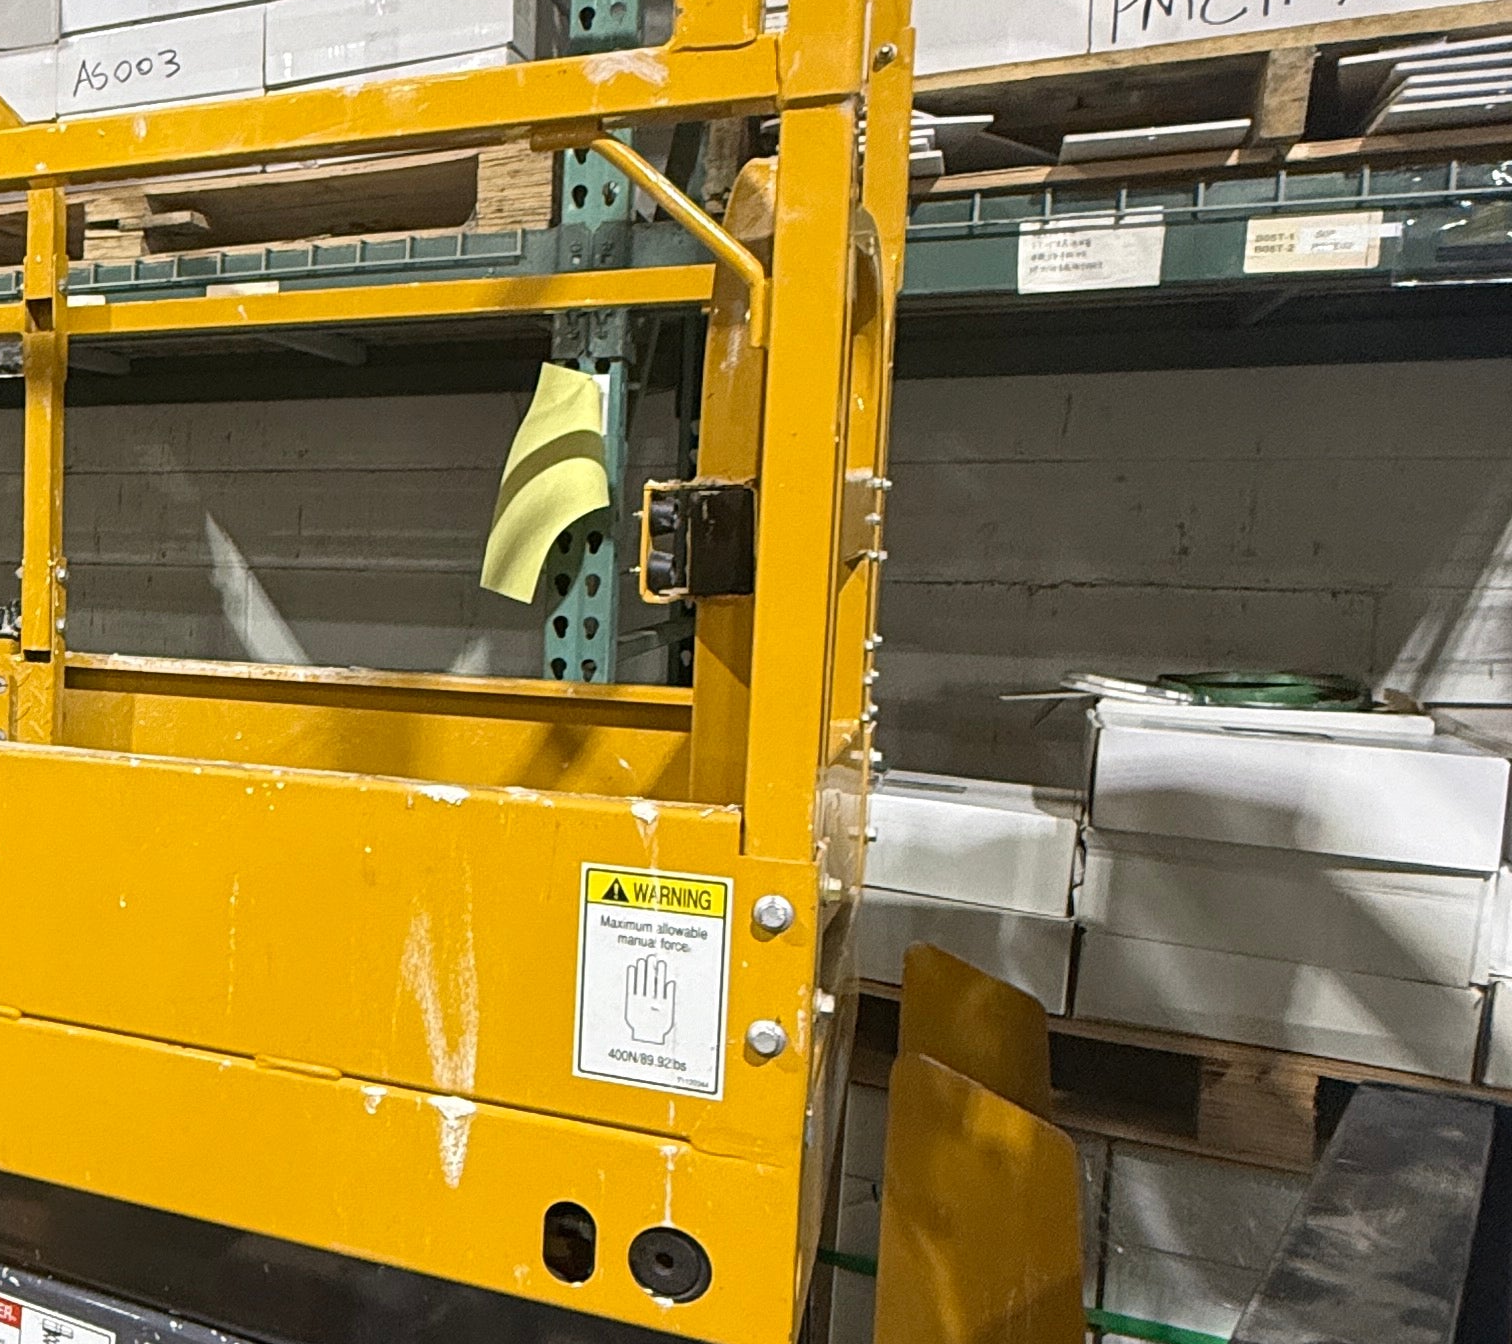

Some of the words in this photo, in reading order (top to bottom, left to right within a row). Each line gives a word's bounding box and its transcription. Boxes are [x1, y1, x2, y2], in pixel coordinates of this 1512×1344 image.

[72, 48, 180, 97] AS003
[633, 882, 711, 911] WARNING
[600, 914, 653, 933] Maximum
[656, 923, 708, 941] allowable
